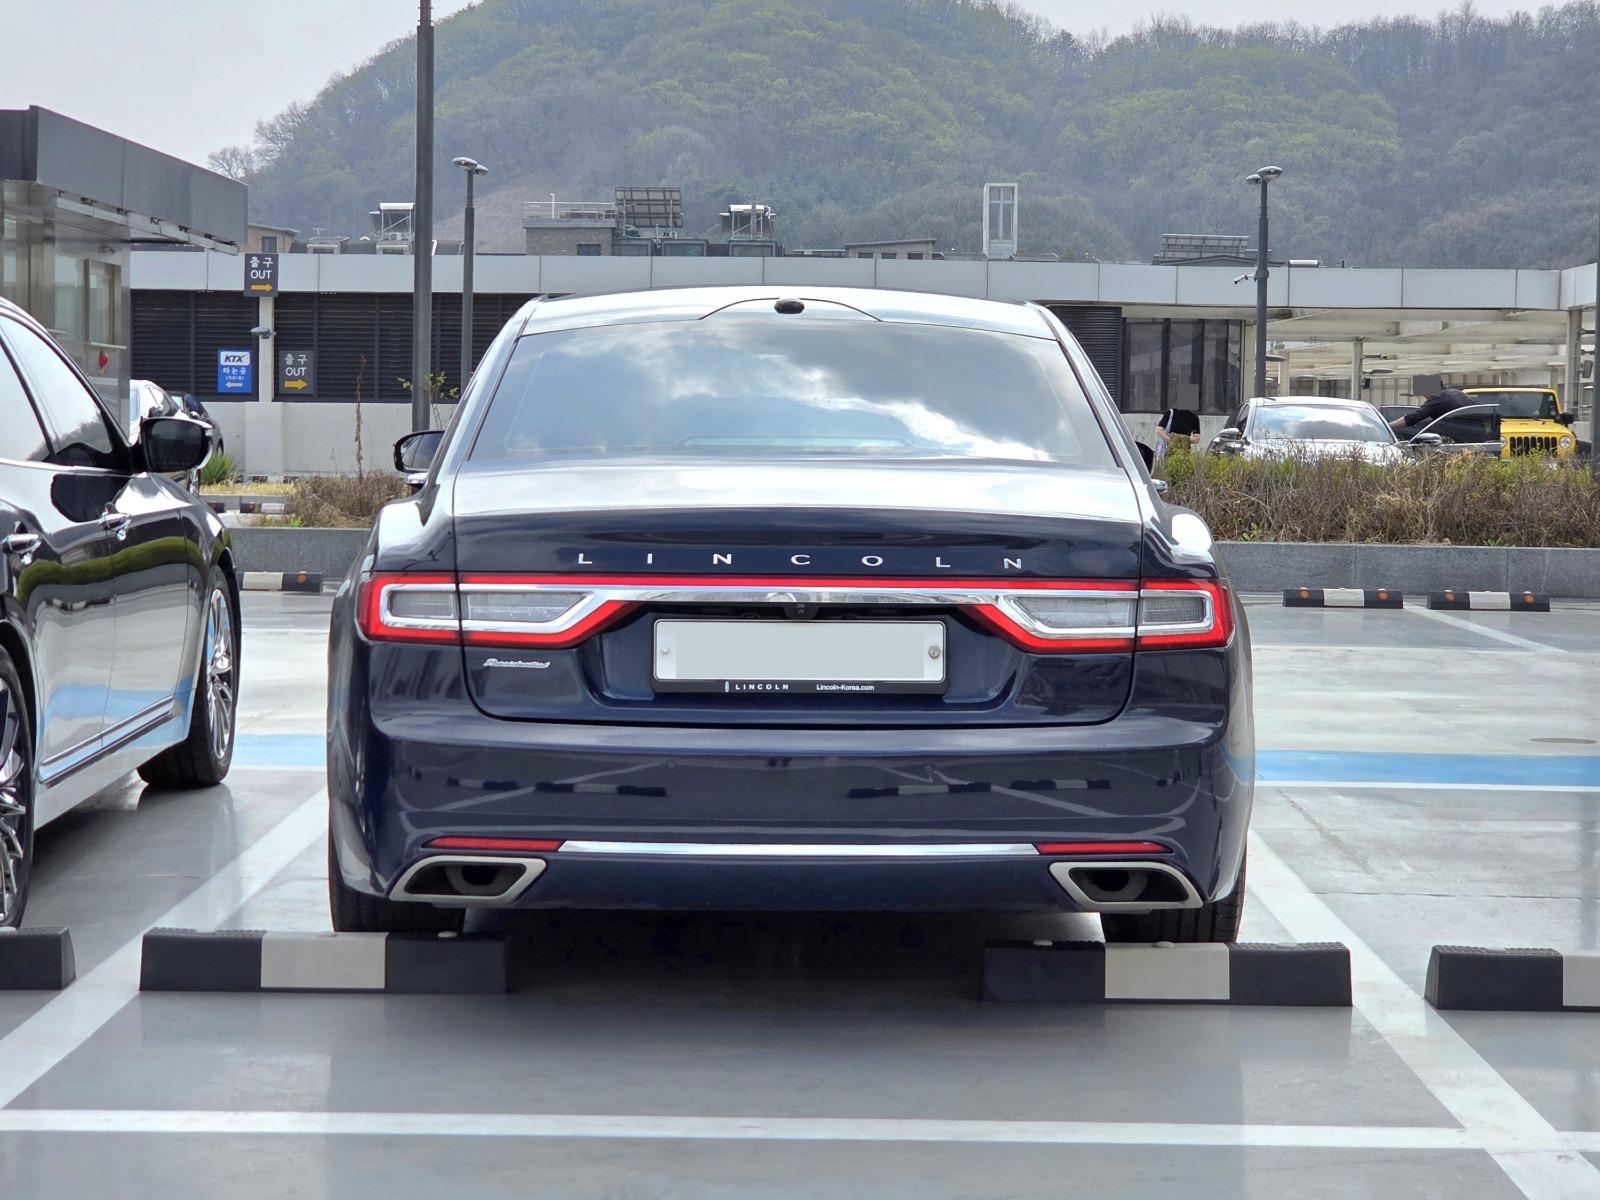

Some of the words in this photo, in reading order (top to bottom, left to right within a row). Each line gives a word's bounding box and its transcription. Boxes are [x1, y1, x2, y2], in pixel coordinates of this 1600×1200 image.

[250, 269, 273, 279] OUT
[224, 355, 246, 363] KTX
[285, 367, 307, 376] OUT
[578, 553, 1022, 569] LINCOLN
[735, 683, 789, 691] LINCOLN
[816, 683, 875, 691] Lincoln-Korea.com
